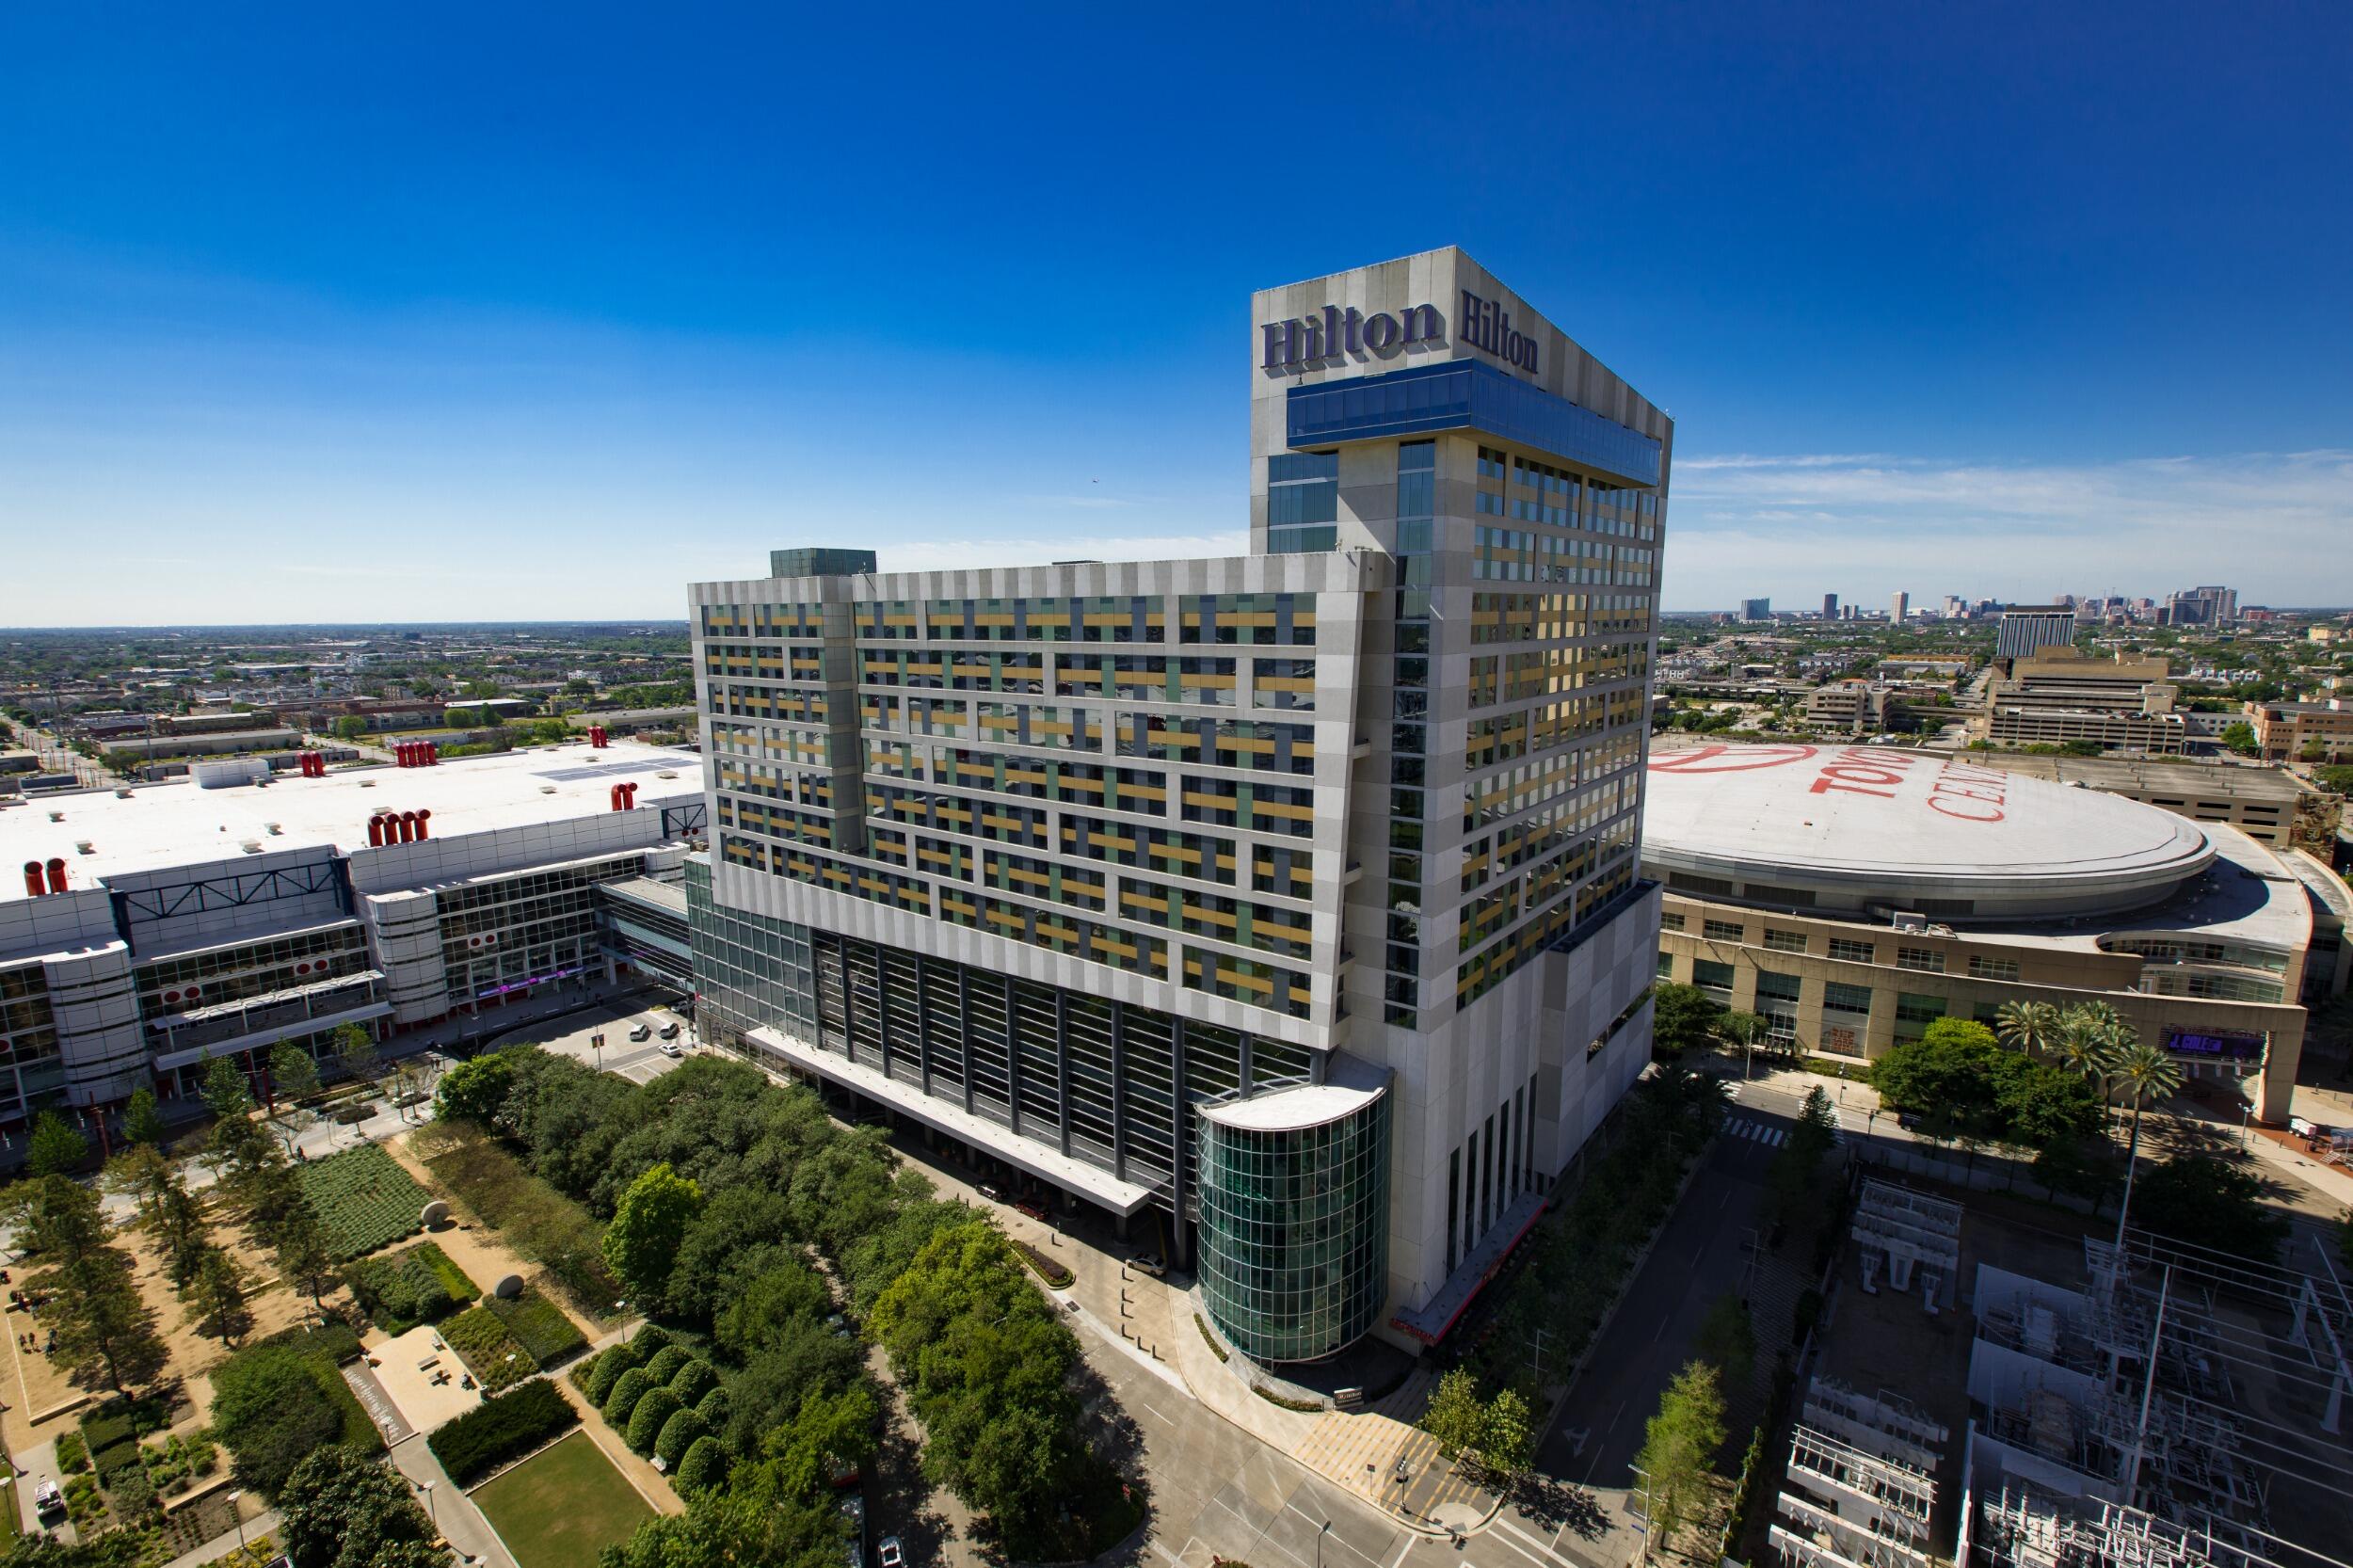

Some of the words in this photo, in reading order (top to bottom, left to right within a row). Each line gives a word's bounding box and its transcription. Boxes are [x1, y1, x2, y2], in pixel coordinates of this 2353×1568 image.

[1260, 302, 1441, 370] Hilton
[1458, 288, 1539, 375] Hilton
[1809, 746, 1916, 799] TOYO
[1927, 760, 2009, 823] CENT
